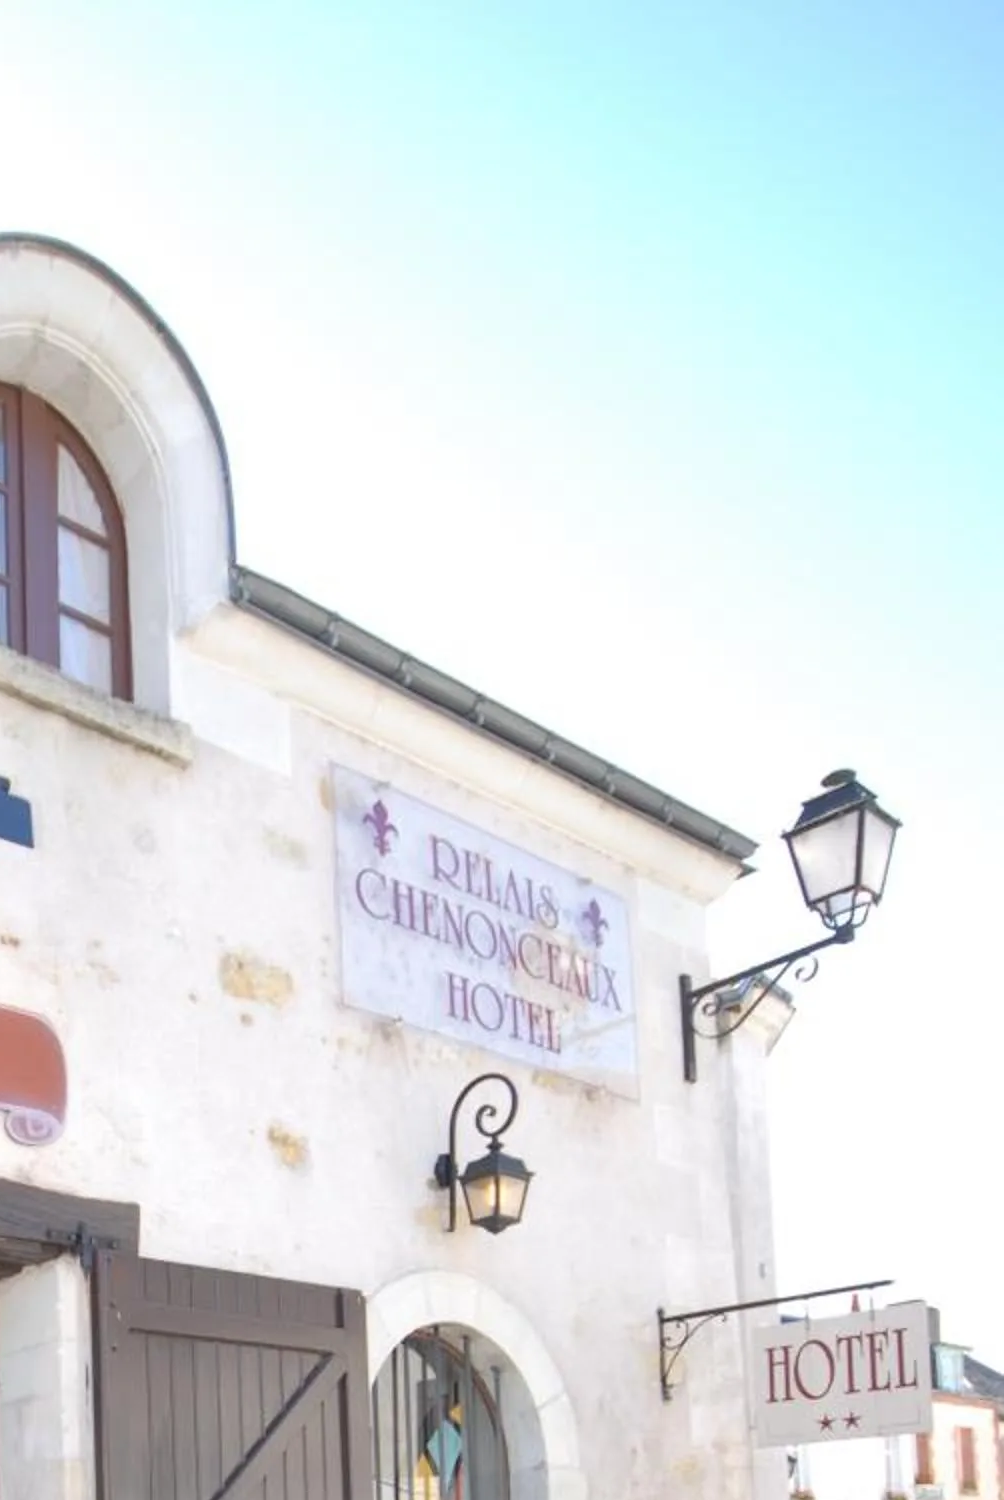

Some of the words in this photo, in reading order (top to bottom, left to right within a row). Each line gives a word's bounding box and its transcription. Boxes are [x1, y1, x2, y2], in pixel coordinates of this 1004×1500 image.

[430, 835, 559, 930] RELAIS
[356, 868, 622, 1012] CHENONCEAUX
[447, 972, 561, 1054] HOTEL
[766, 1328, 917, 1403] HOTEL
